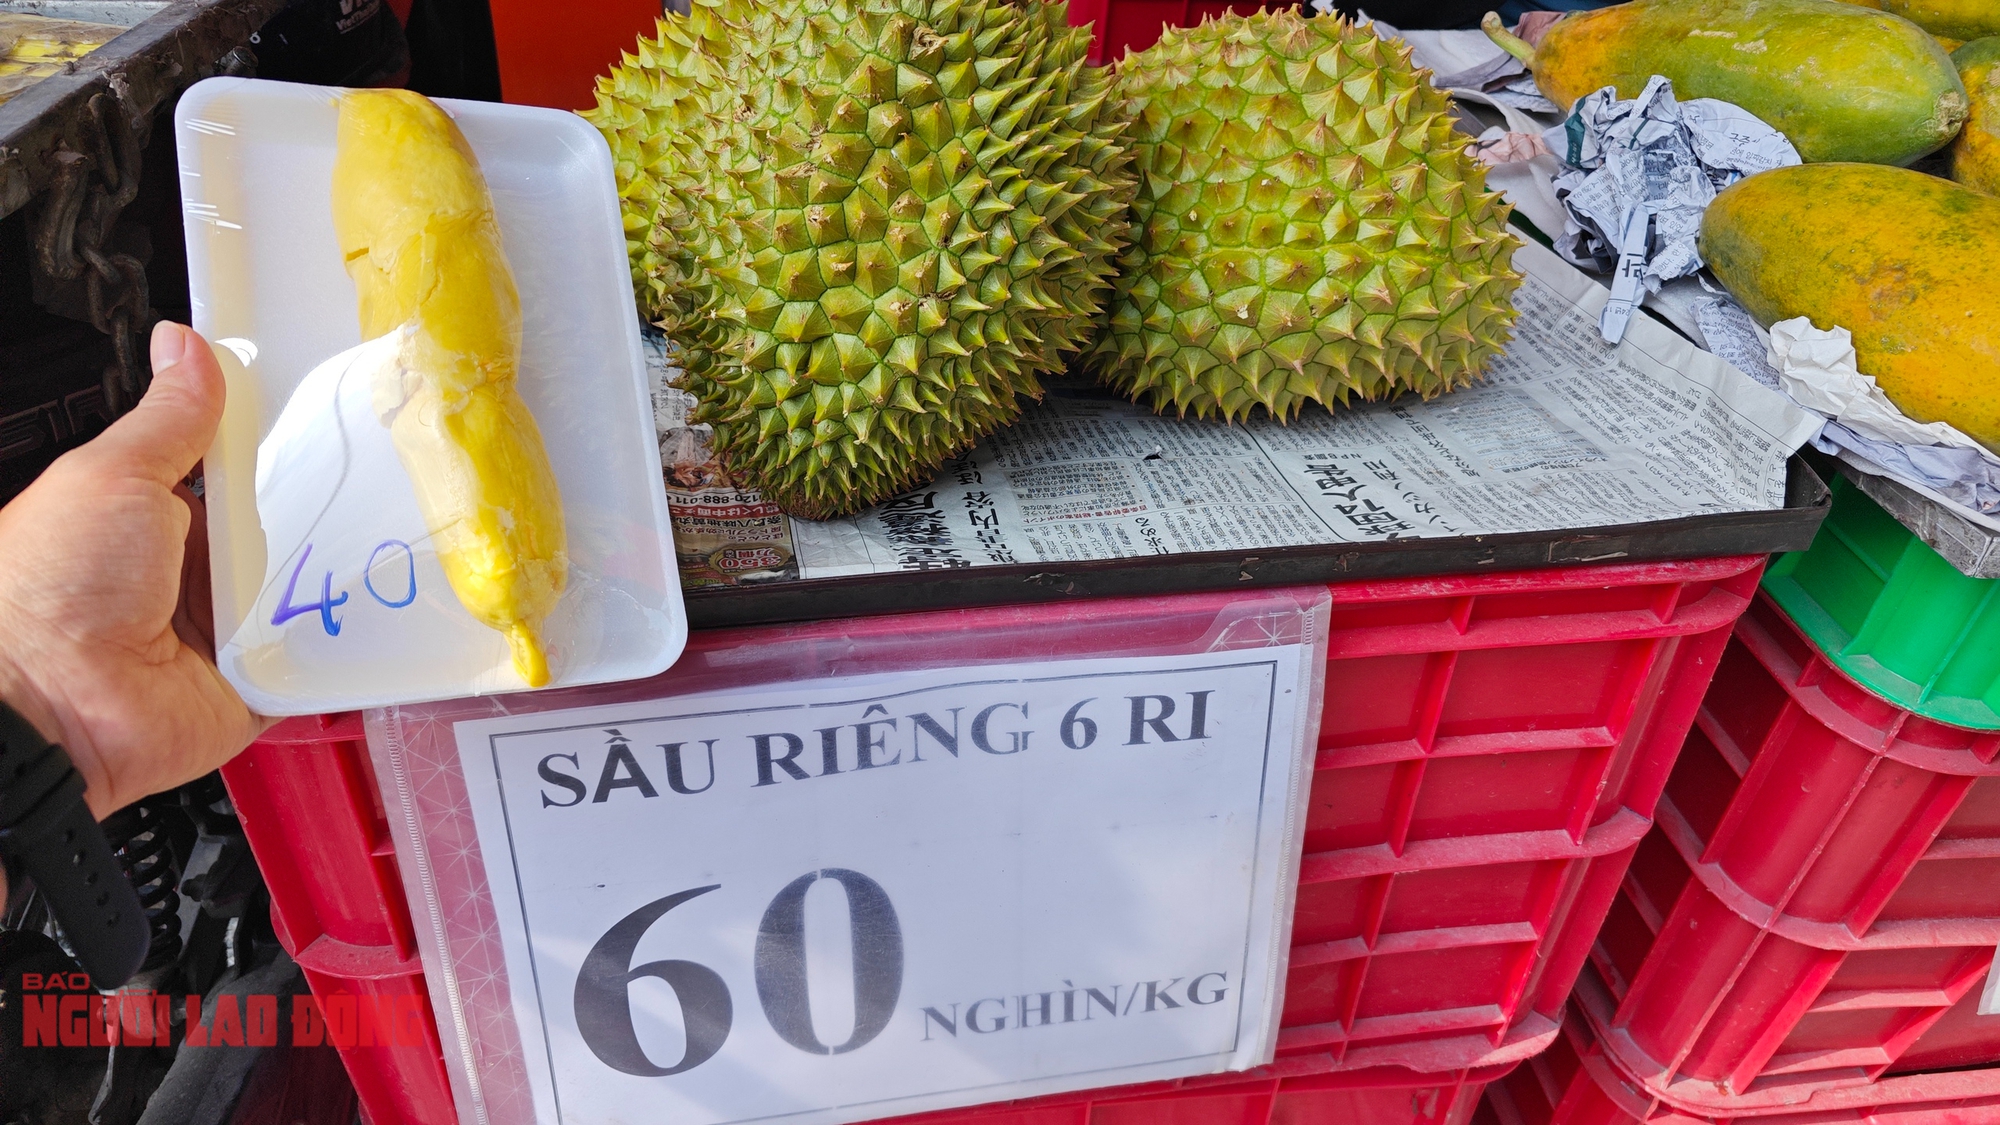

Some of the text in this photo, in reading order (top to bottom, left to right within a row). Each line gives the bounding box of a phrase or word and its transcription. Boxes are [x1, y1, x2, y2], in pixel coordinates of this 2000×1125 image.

[271, 539, 416, 637] 40
[536, 690, 1217, 810] SẦU RIÊNG 6 RI
[573, 867, 1229, 1078] 60 NGHÌN/KG
